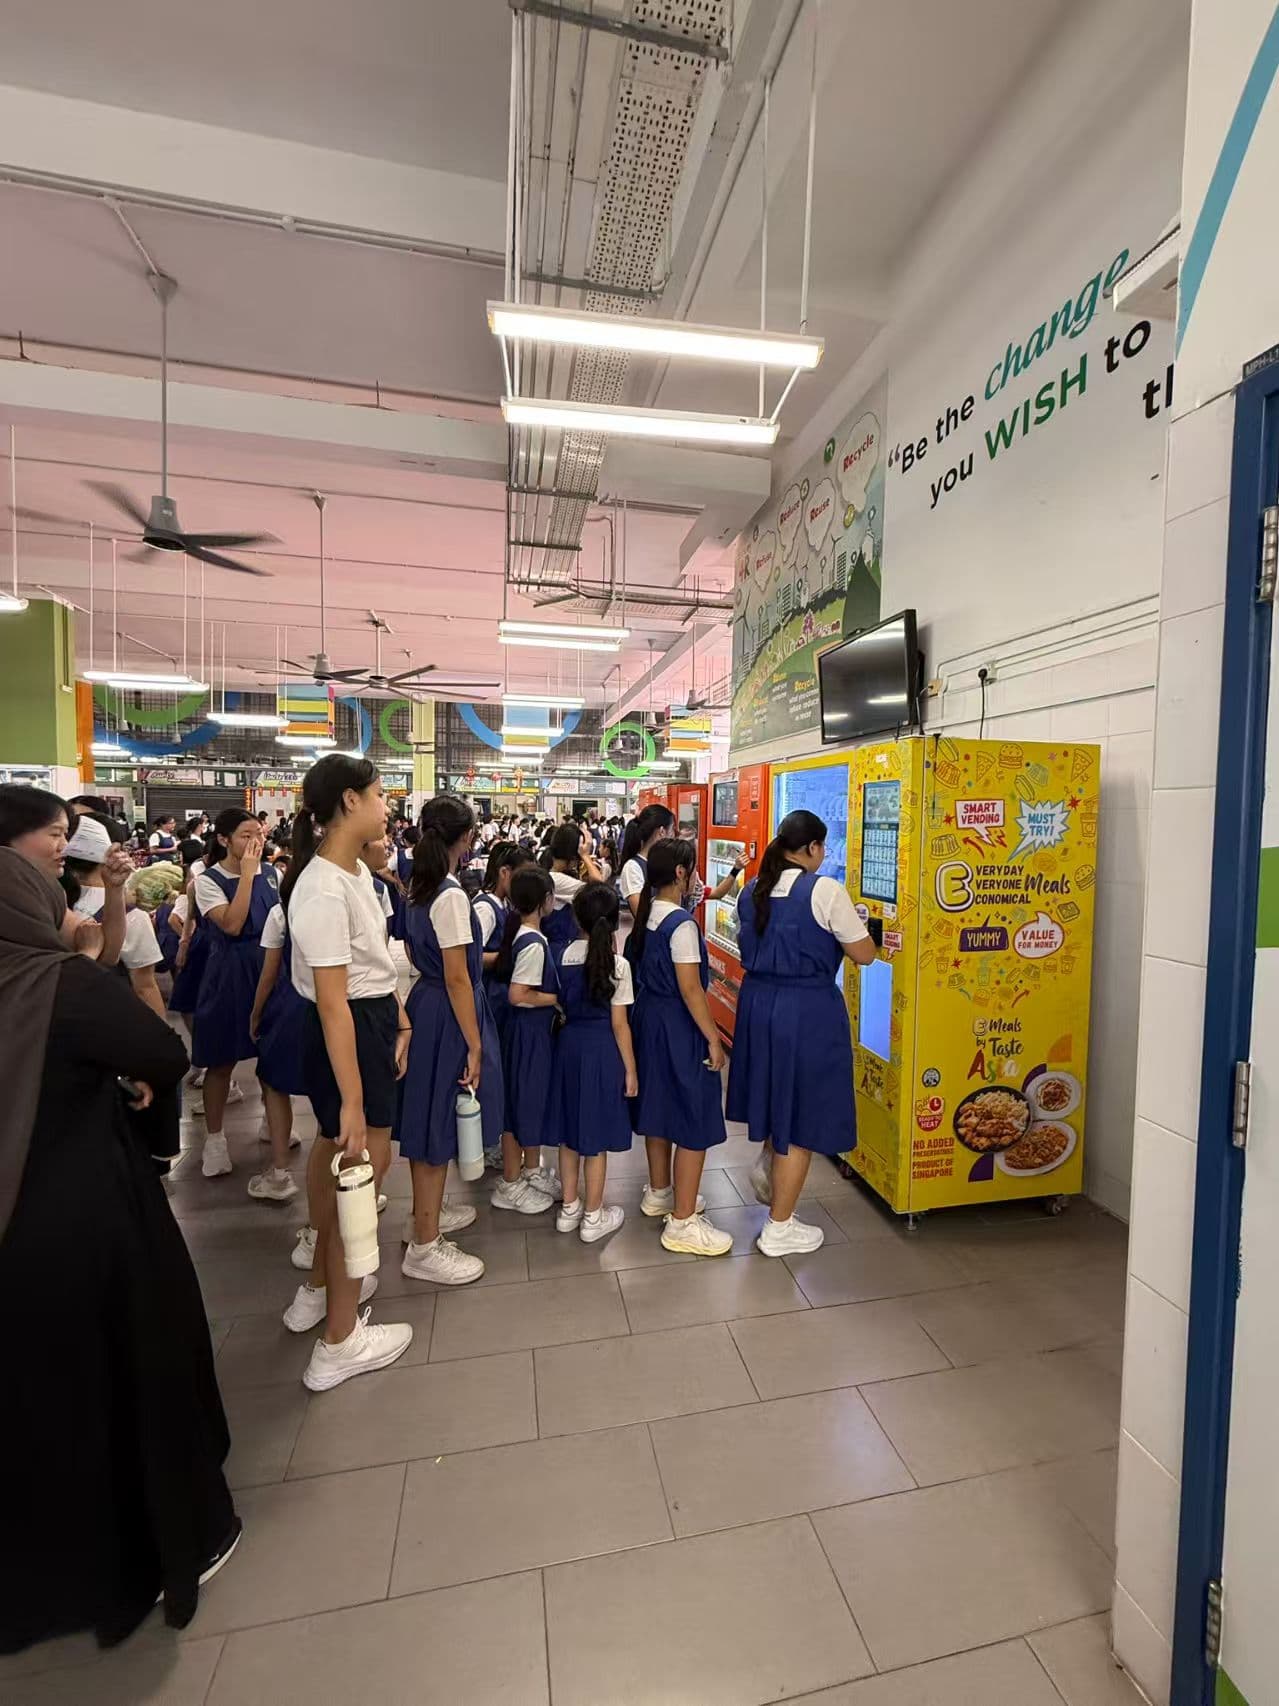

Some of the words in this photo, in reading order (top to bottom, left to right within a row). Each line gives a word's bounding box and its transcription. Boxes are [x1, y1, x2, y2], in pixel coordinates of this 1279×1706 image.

[935, 395, 975, 444] the
[984, 248, 1130, 401] change
[930, 452, 974, 509] you
[984, 352, 1088, 460] WISH
[1104, 320, 1152, 374] to
[843, 433, 875, 472] Recycle
[810, 497, 830, 523] Reuse
[963, 802, 997, 813] SMART
[961, 813, 1000, 825] VENDING
[1027, 813, 1056, 824] MUST
[1029, 824, 1055, 836] TRY!
[935, 860, 975, 913] E
[976, 865, 1025, 876] VERYDAY
[976, 879, 1022, 890] VERYONE
[1024, 872, 1071, 896] Meals
[975, 893, 1032, 905] CONOMICAL
[966, 931, 1002, 948] YUMMY
[1021, 930, 1055, 940] VALUE
[1017, 940, 1033, 949] FOR
[1034, 940, 1058, 949] MONEY
[988, 1017, 1022, 1033] Meals
[976, 1036, 986, 1049] by
[988, 1037, 1024, 1058] Taste
[912, 1141, 924, 1150] NO
[928, 1137, 954, 1149] ADDED
[912, 1168, 953, 1179] SINGAPORE
